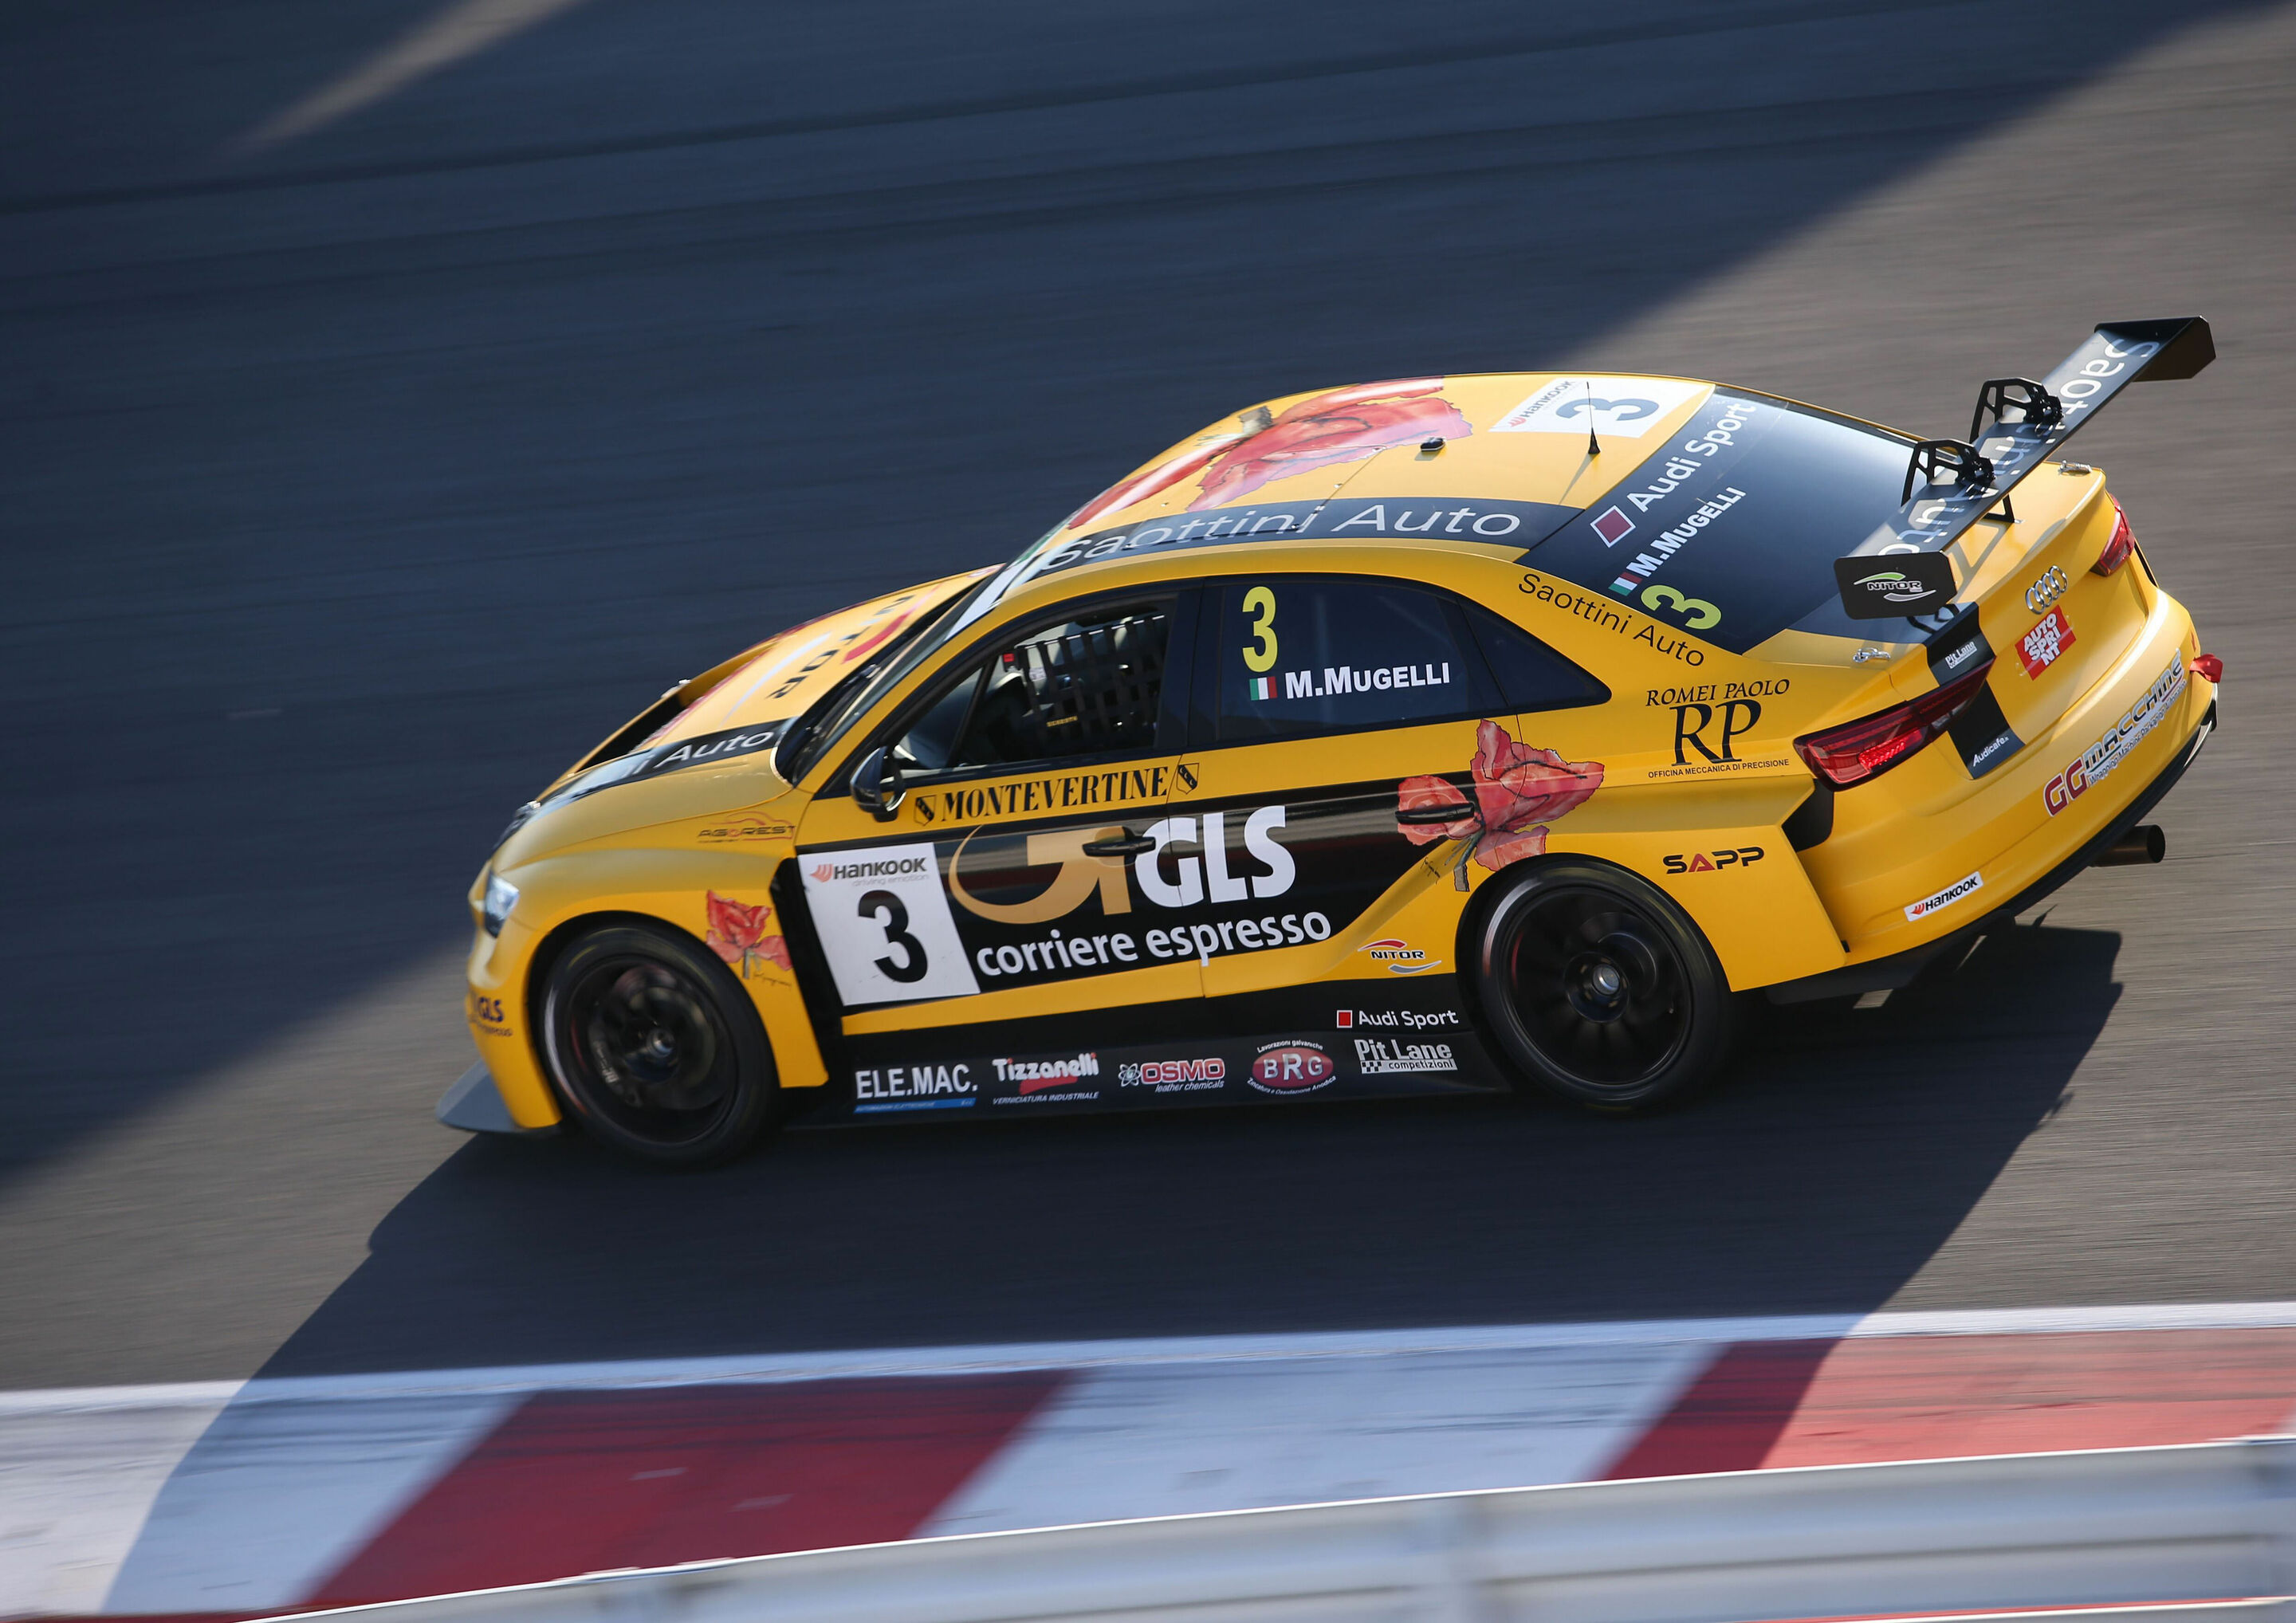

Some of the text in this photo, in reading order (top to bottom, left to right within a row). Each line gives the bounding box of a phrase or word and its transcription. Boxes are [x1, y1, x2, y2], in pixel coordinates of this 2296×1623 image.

[1555, 398, 1660, 421] 3
[1626, 401, 1757, 513] Audi Sport
[1040, 503, 1521, 571] Saottini Auto
[1867, 580, 1922, 592] NITOR
[1518, 573, 1704, 666] Saottini Auto
[1641, 584, 1722, 630] 3
[1242, 586, 1279, 673] 3
[2024, 613, 2057, 652] AUTO
[2028, 626, 2061, 661] SPRI
[2040, 642, 2060, 666] NT
[1284, 662, 1450, 699] M.MUGELLI
[1645, 678, 1791, 706] ROMEI PAOLO
[1669, 698, 1762, 766] RP
[653, 731, 774, 768] Auto
[1648, 768, 1684, 779] OFFICINA
[1685, 764, 1732, 776] MECCANICA
[1742, 759, 1790, 770] PRECISIONE
[941, 766, 1169, 822] MONTEVERTINE
[1134, 805, 1296, 908] GLS
[1662, 847, 1764, 874] SAPP
[858, 889, 928, 984] 3
[977, 910, 1331, 977] corriere espresso
[1370, 950, 1425, 960] NITOR
[1358, 1010, 1459, 1030] Audi Sport
[1256, 1039, 1323, 1053] Lavorazioni galvaniche
[1354, 1039, 1453, 1060] Pit Lane
[993, 1052, 1099, 1082] Tizzanelli
[1141, 1058, 1225, 1085] OSMO
[1263, 1053, 1323, 1081] BRG
[1389, 1059, 1453, 1071] competizioni
[855, 1063, 978, 1099] ELE.MAC.
[1154, 1079, 1225, 1093] leather chemicals
[1247, 1077, 1271, 1094] Zincatura
[1311, 1075, 1337, 1091] Anodica
[993, 1091, 1100, 1106] VERNICIATURA INDUSTRIALE
